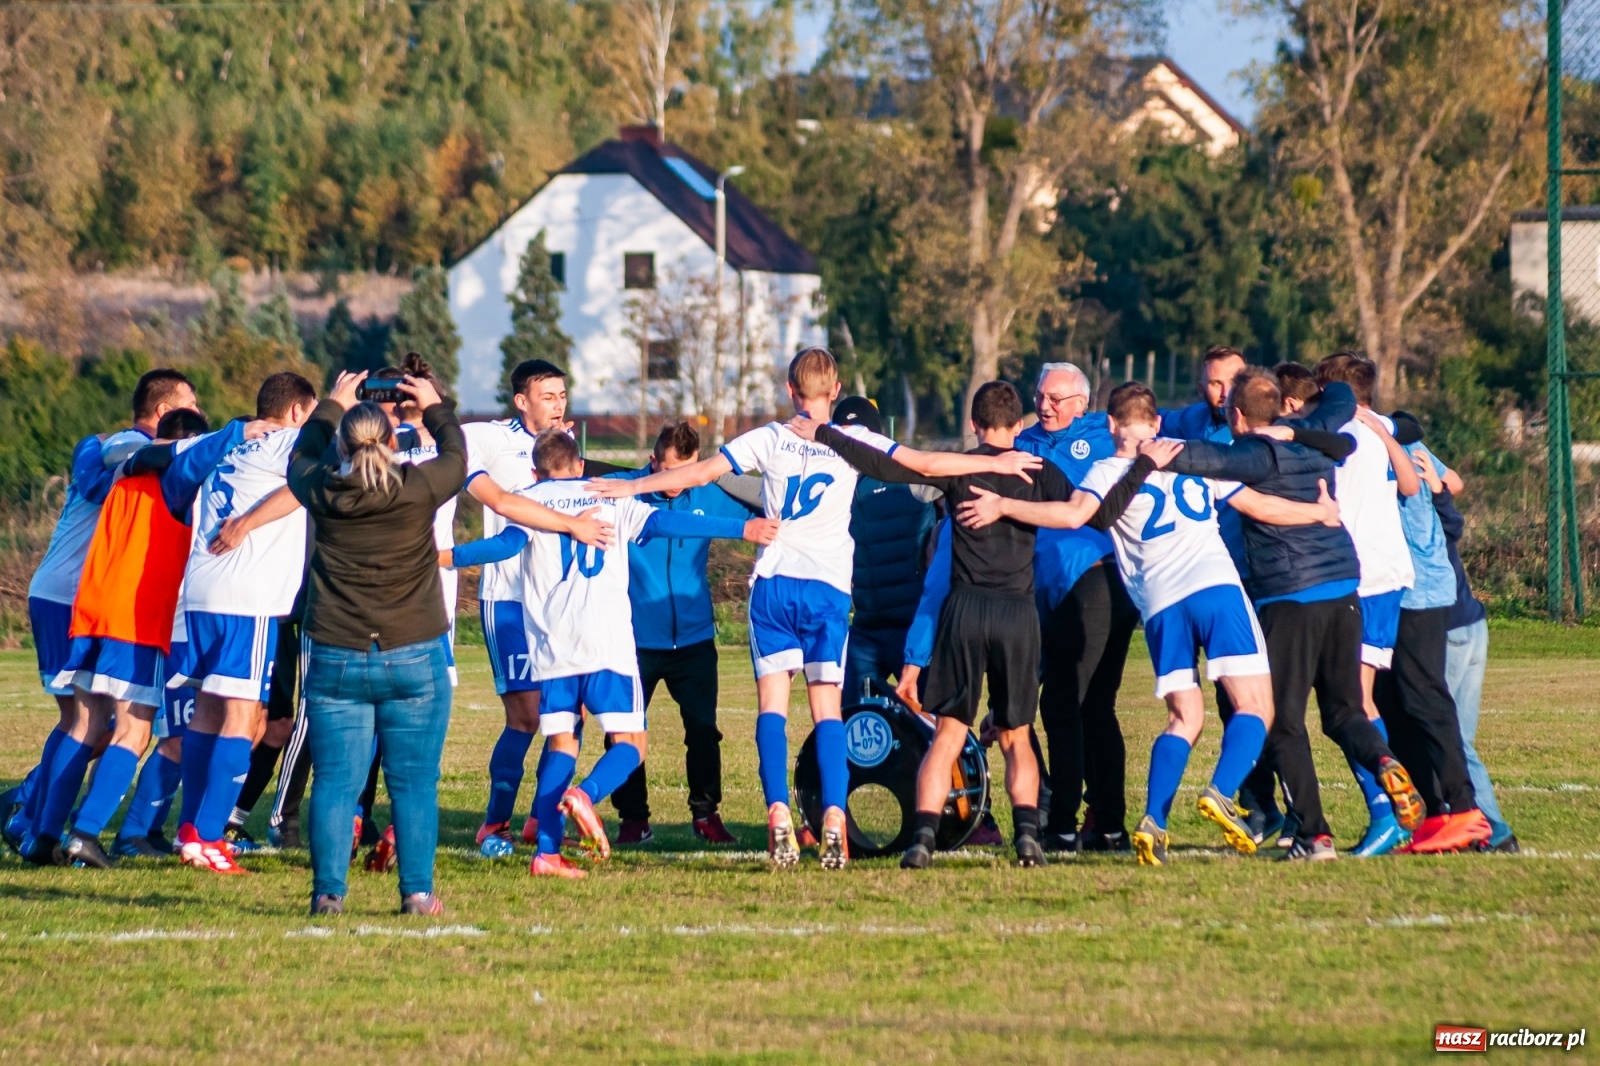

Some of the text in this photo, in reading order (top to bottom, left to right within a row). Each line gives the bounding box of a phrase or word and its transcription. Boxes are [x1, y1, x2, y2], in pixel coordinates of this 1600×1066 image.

[557, 498, 571, 509] 07
[1138, 473, 1212, 541] 20
[557, 532, 605, 581] 10
[508, 654, 530, 680] 17
[173, 698, 195, 726] 16
[851, 718, 884, 747] LKS
[862, 738, 873, 750] 07
